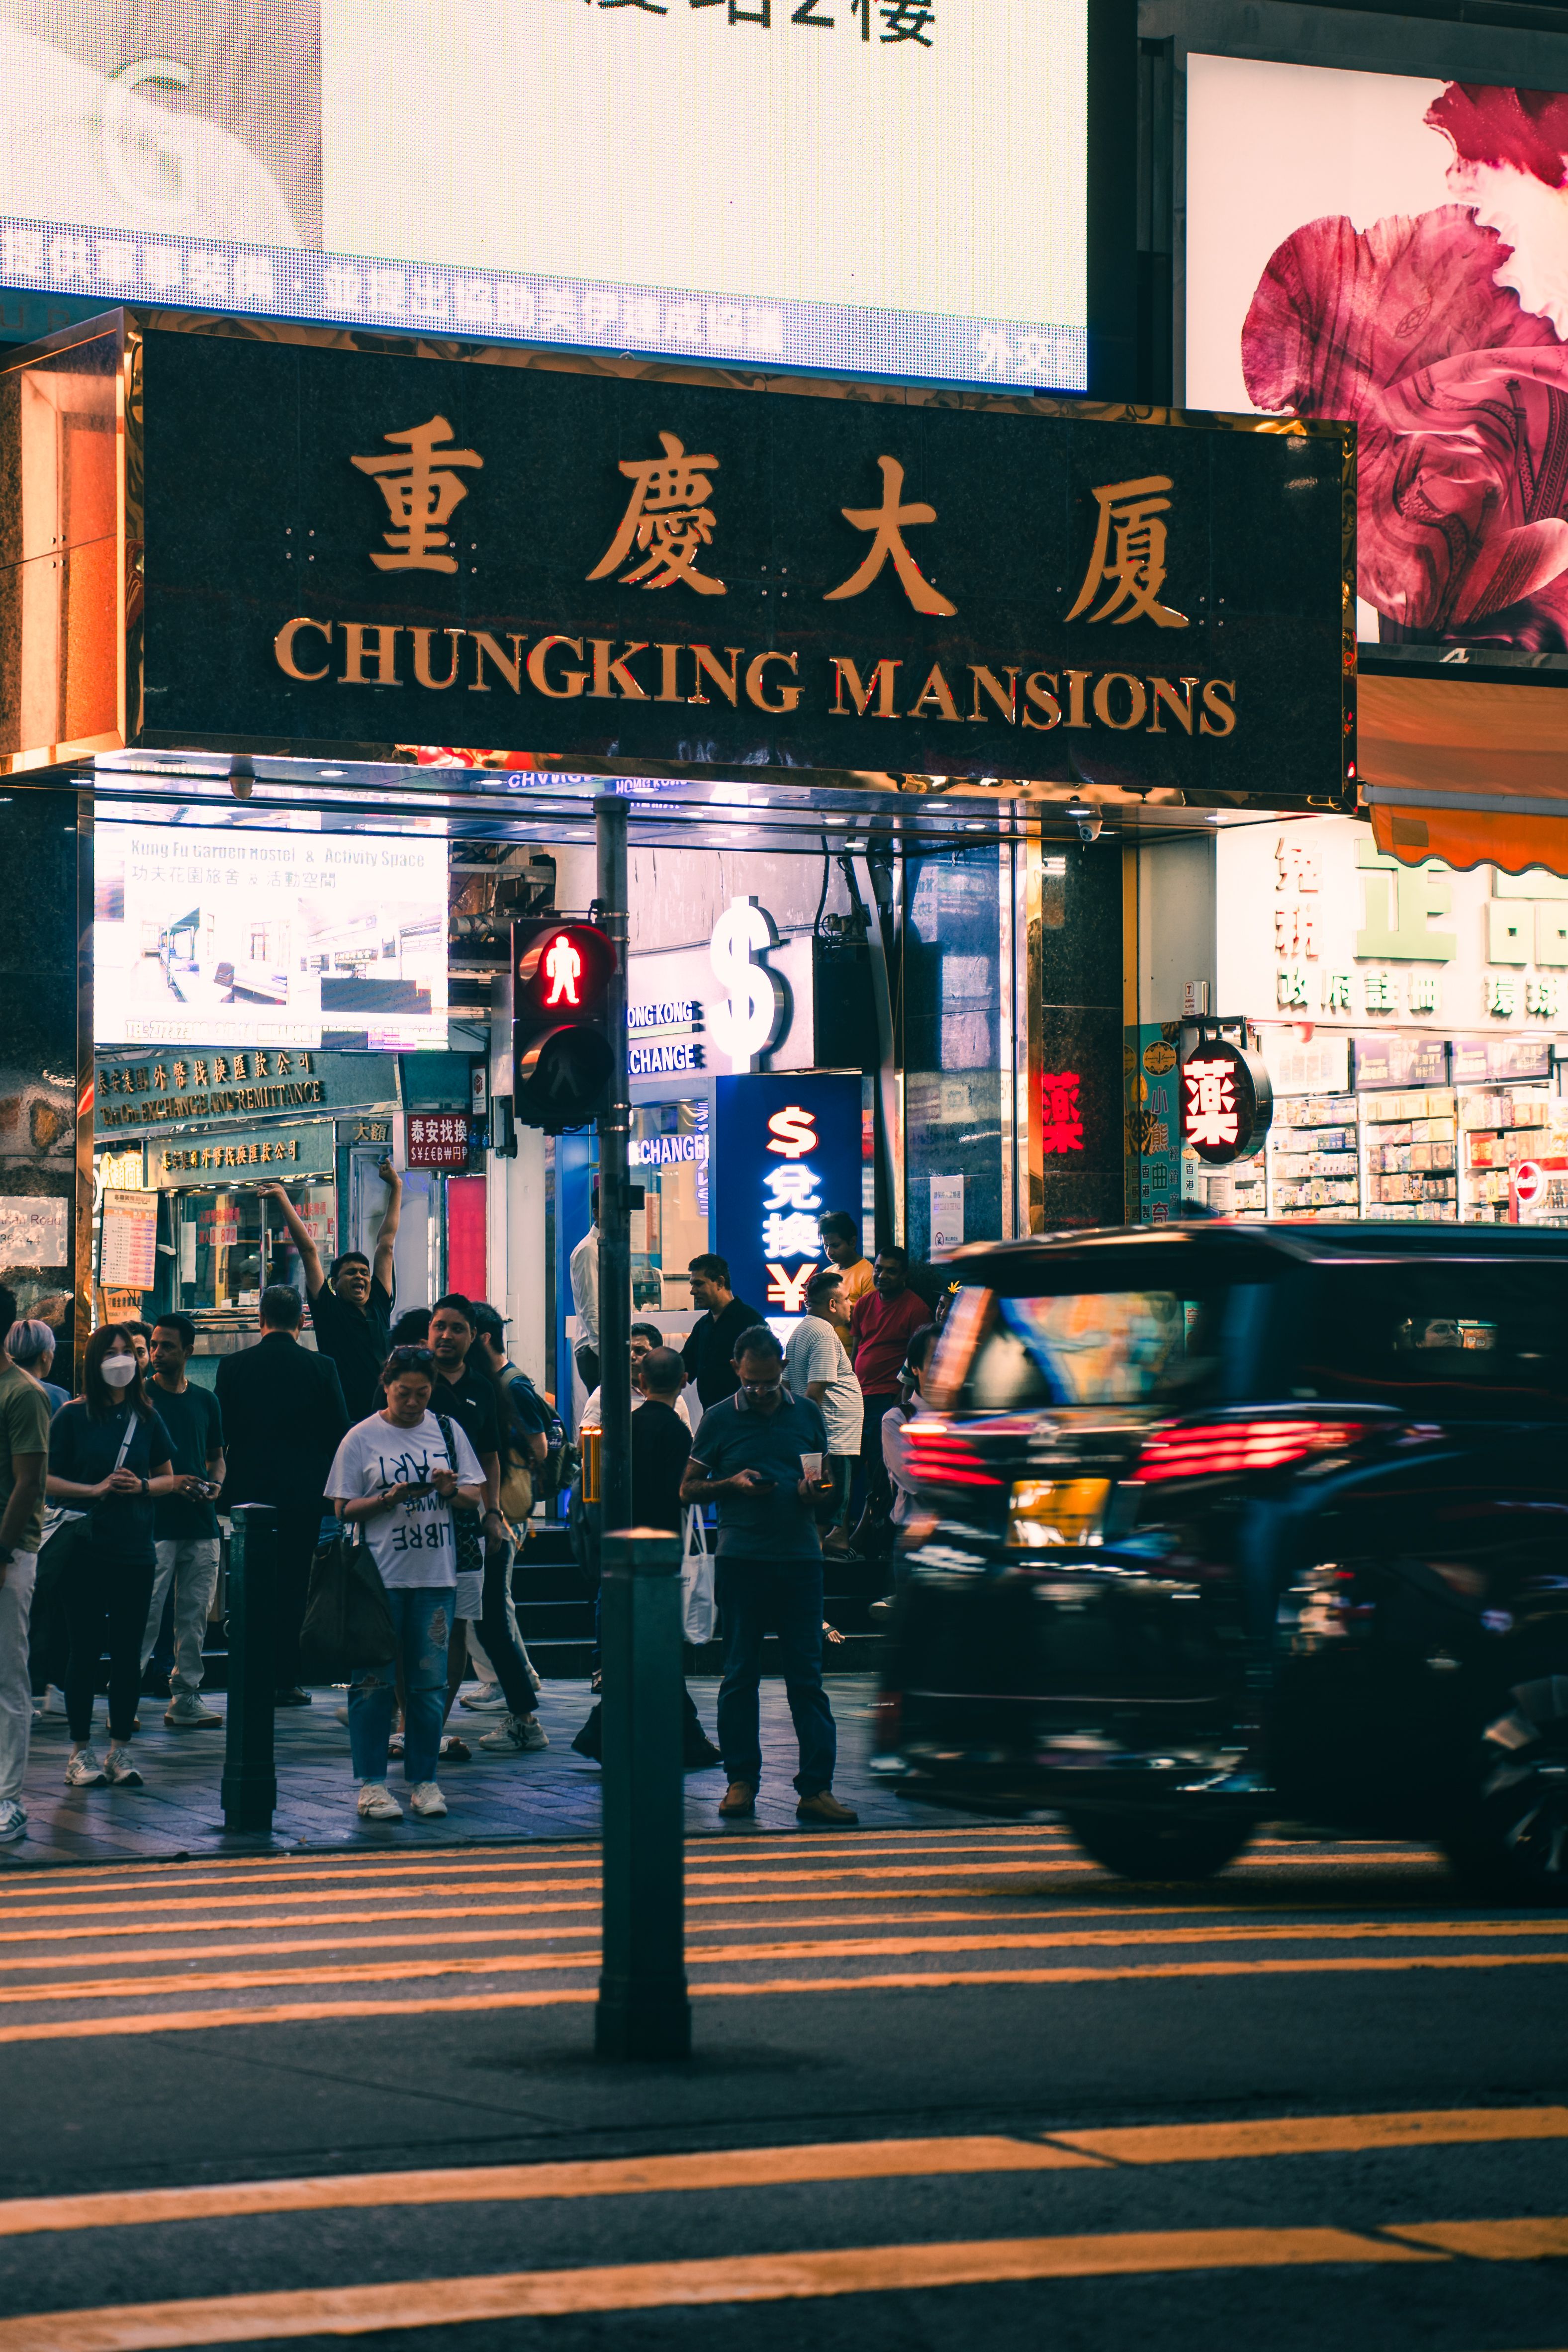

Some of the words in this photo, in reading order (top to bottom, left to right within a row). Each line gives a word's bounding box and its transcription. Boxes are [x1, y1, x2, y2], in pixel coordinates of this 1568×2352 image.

[274, 617, 805, 713] CHUNGKING
[828, 656, 1237, 737] MANSIONS
[132, 839, 169, 859] Kung
[173, 841, 188, 857] Fu
[193, 845, 245, 860] Garden
[250, 846, 295, 862] Hostel
[306, 850, 314, 863] &
[325, 848, 377, 867] Activity
[381, 850, 425, 868] Space
[132, 865, 239, 885] 功夫花園旅舍
[267, 870, 336, 889] 活動空間
[655, 1000, 693, 1024] KONG
[154, 1051, 314, 1091] 外幣找換匯款公司
[627, 1043, 696, 1075] CHANGE
[141, 1094, 208, 1122] EXCHANGE
[238, 1081, 321, 1110] REMITTANCE
[353, 1122, 389, 1142] 大額
[411, 1119, 467, 1144] 泰安找換
[1150, 1085, 1169, 1222] 小熊曲奇
[30, 1214, 62, 1226] Road
[392, 1523, 451, 1551] LIBRE
